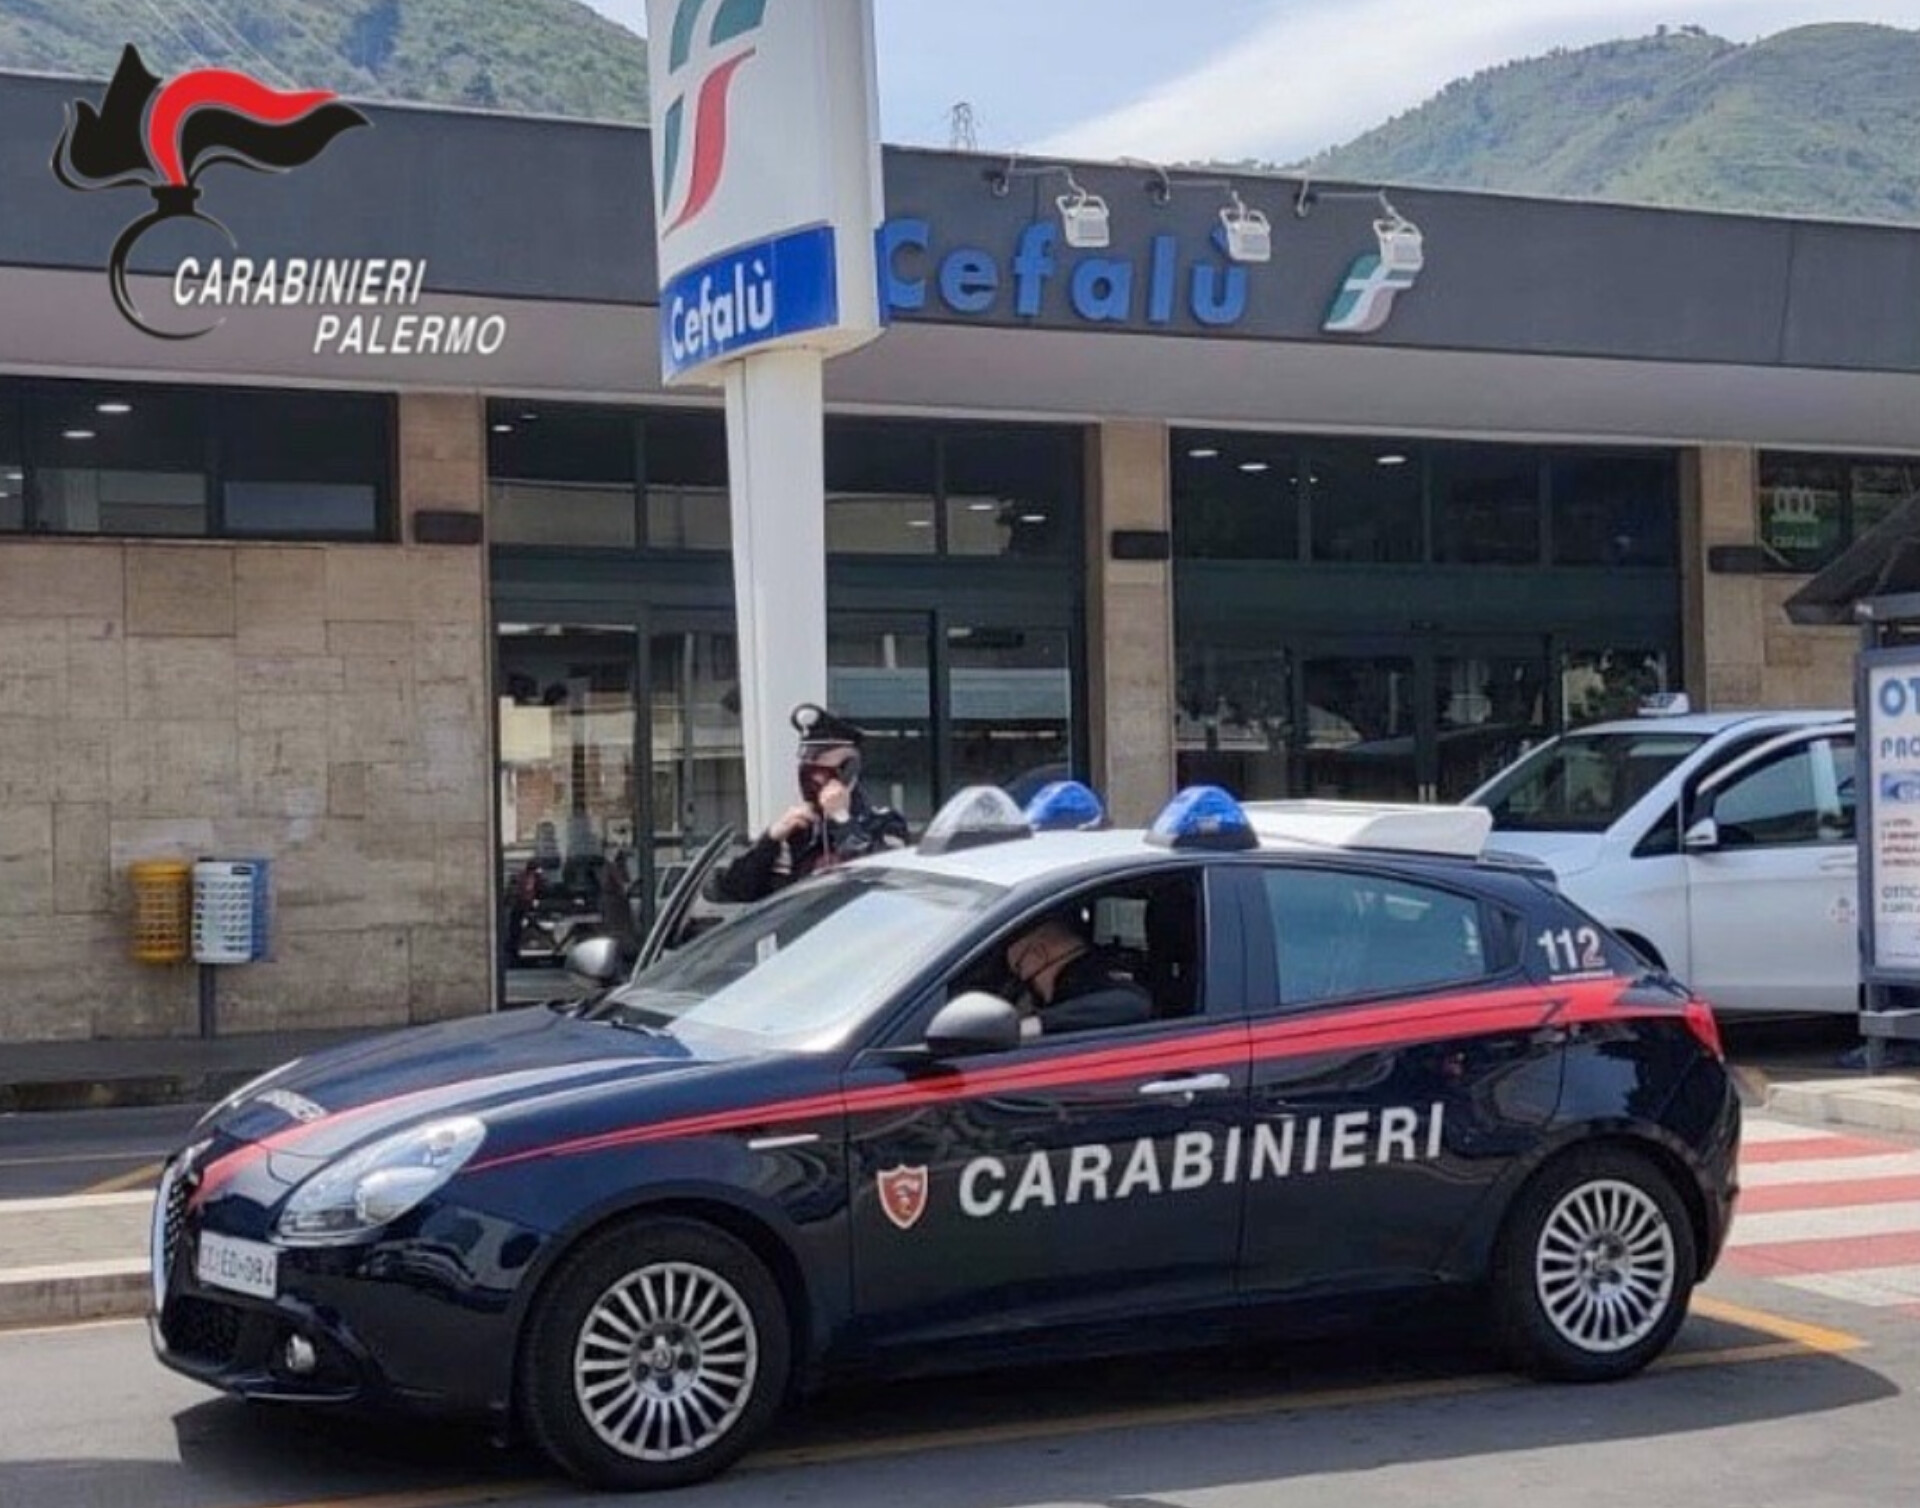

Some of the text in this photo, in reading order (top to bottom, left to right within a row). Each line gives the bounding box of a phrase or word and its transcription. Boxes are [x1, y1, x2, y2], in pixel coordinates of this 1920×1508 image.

[670, 259, 775, 361] Cefalù
[877, 219, 1249, 325] Cefalù
[1537, 926, 1606, 971] 112
[958, 1102, 1445, 1217] CARABINIERI
